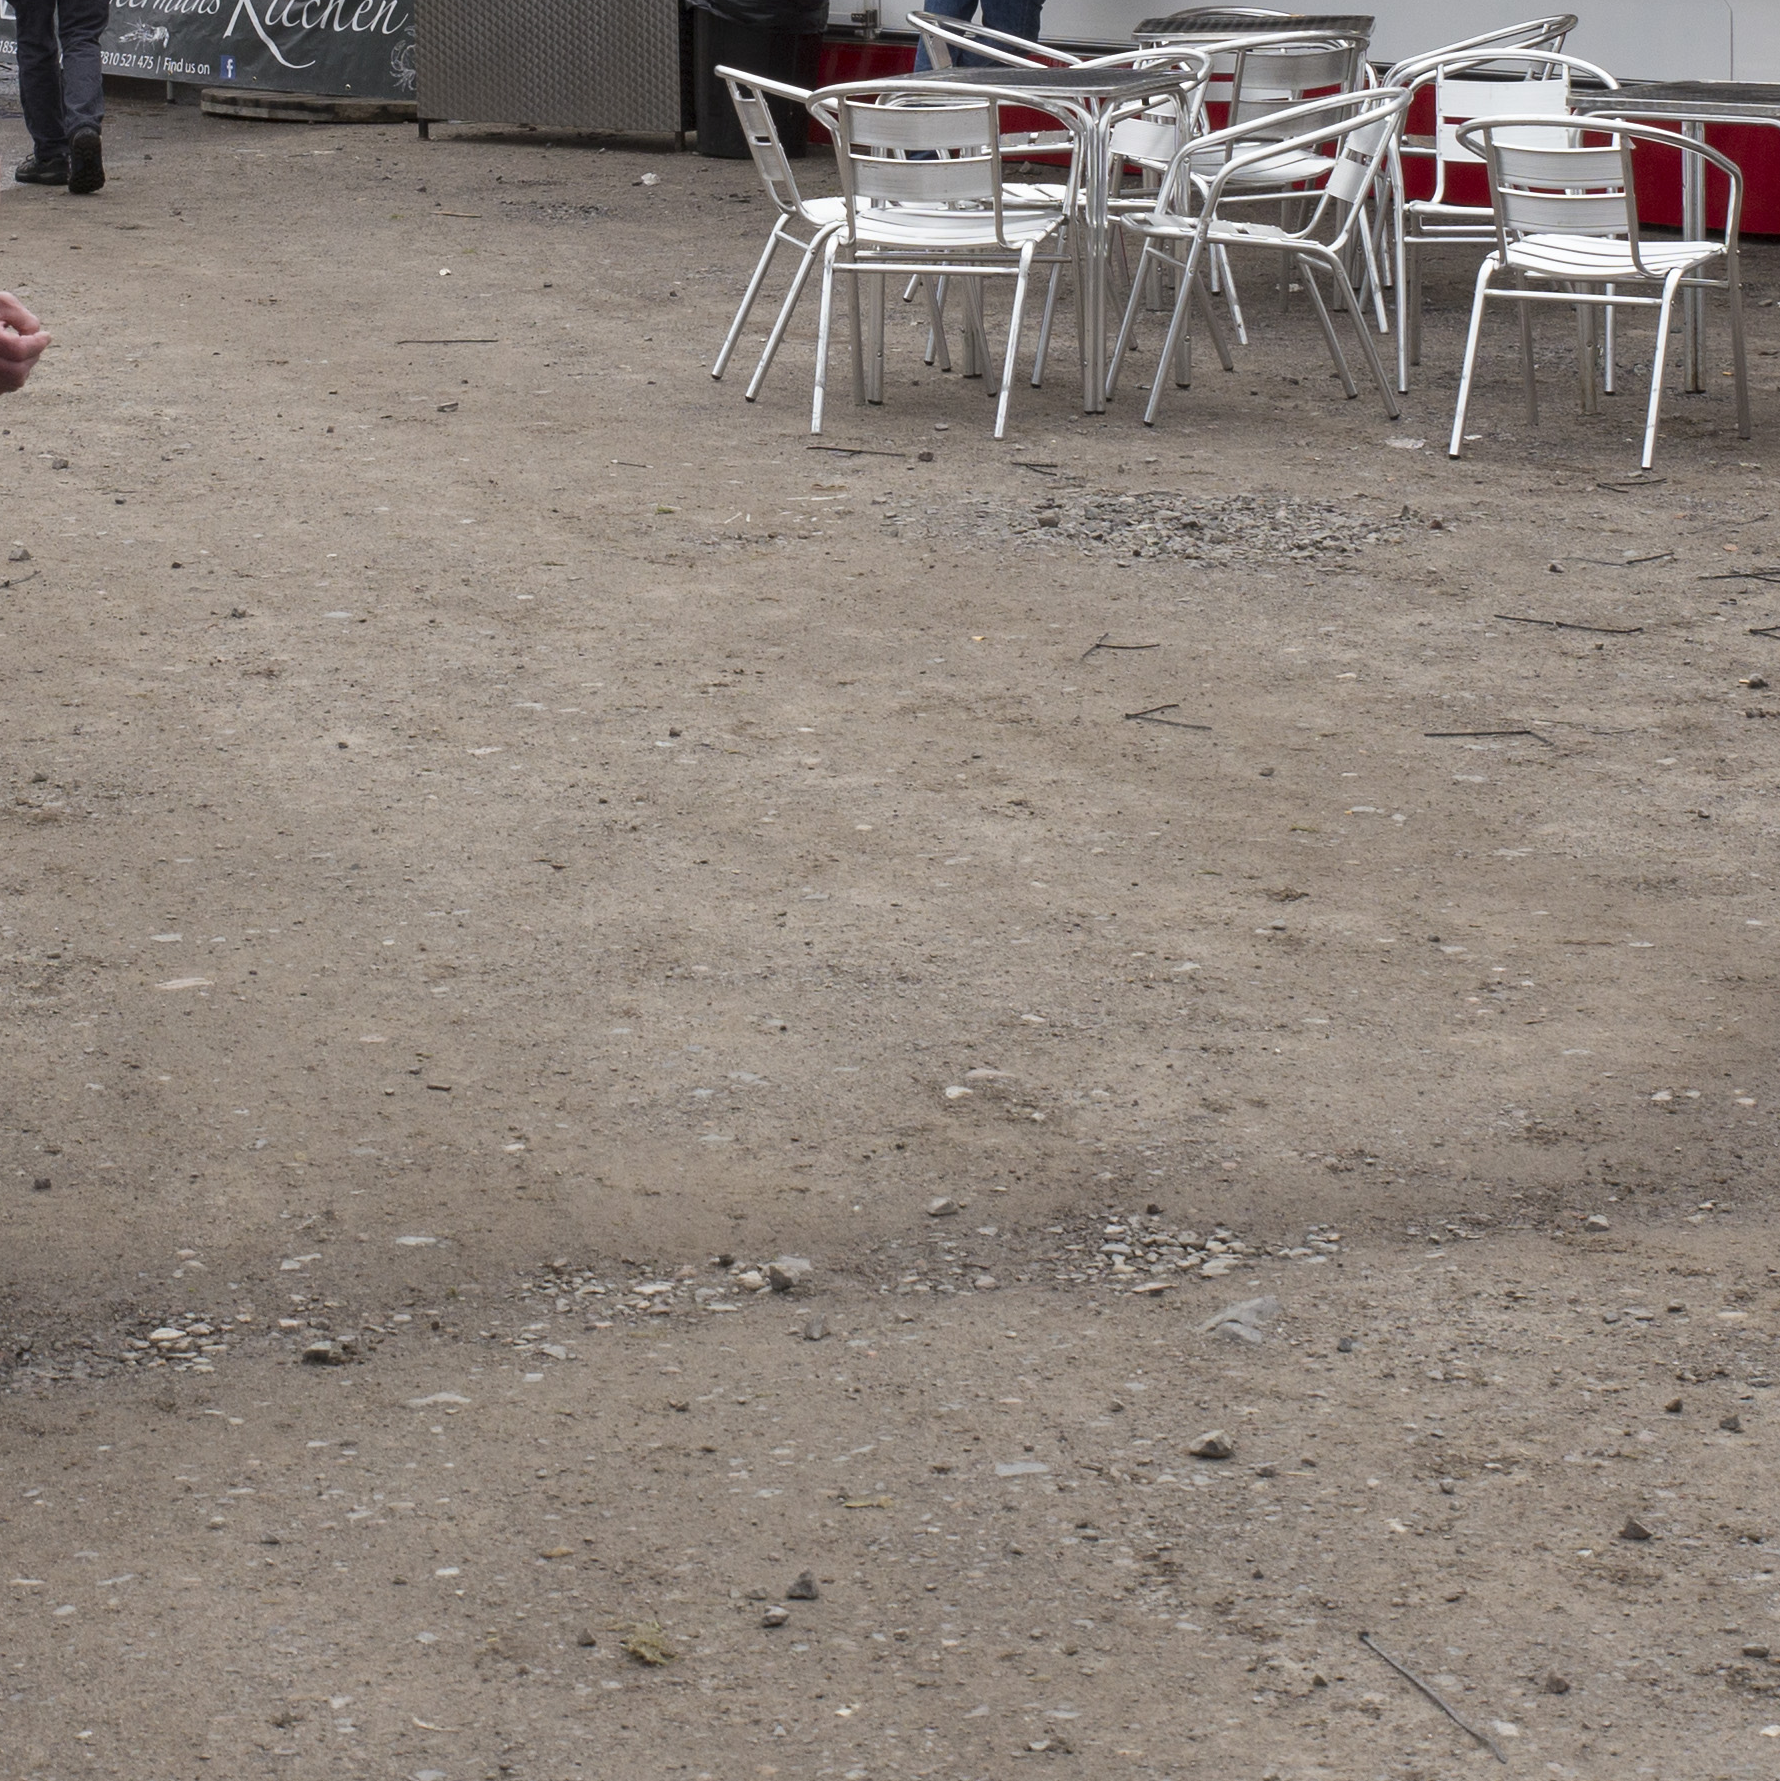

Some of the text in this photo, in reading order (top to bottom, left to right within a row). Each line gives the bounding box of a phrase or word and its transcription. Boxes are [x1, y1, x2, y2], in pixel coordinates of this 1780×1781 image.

[120, 53, 136, 67] 521
[139, 55, 153, 69] 475
[163, 57, 183, 72] Find
[185, 63, 195, 73] us
[197, 64, 210, 75] on
